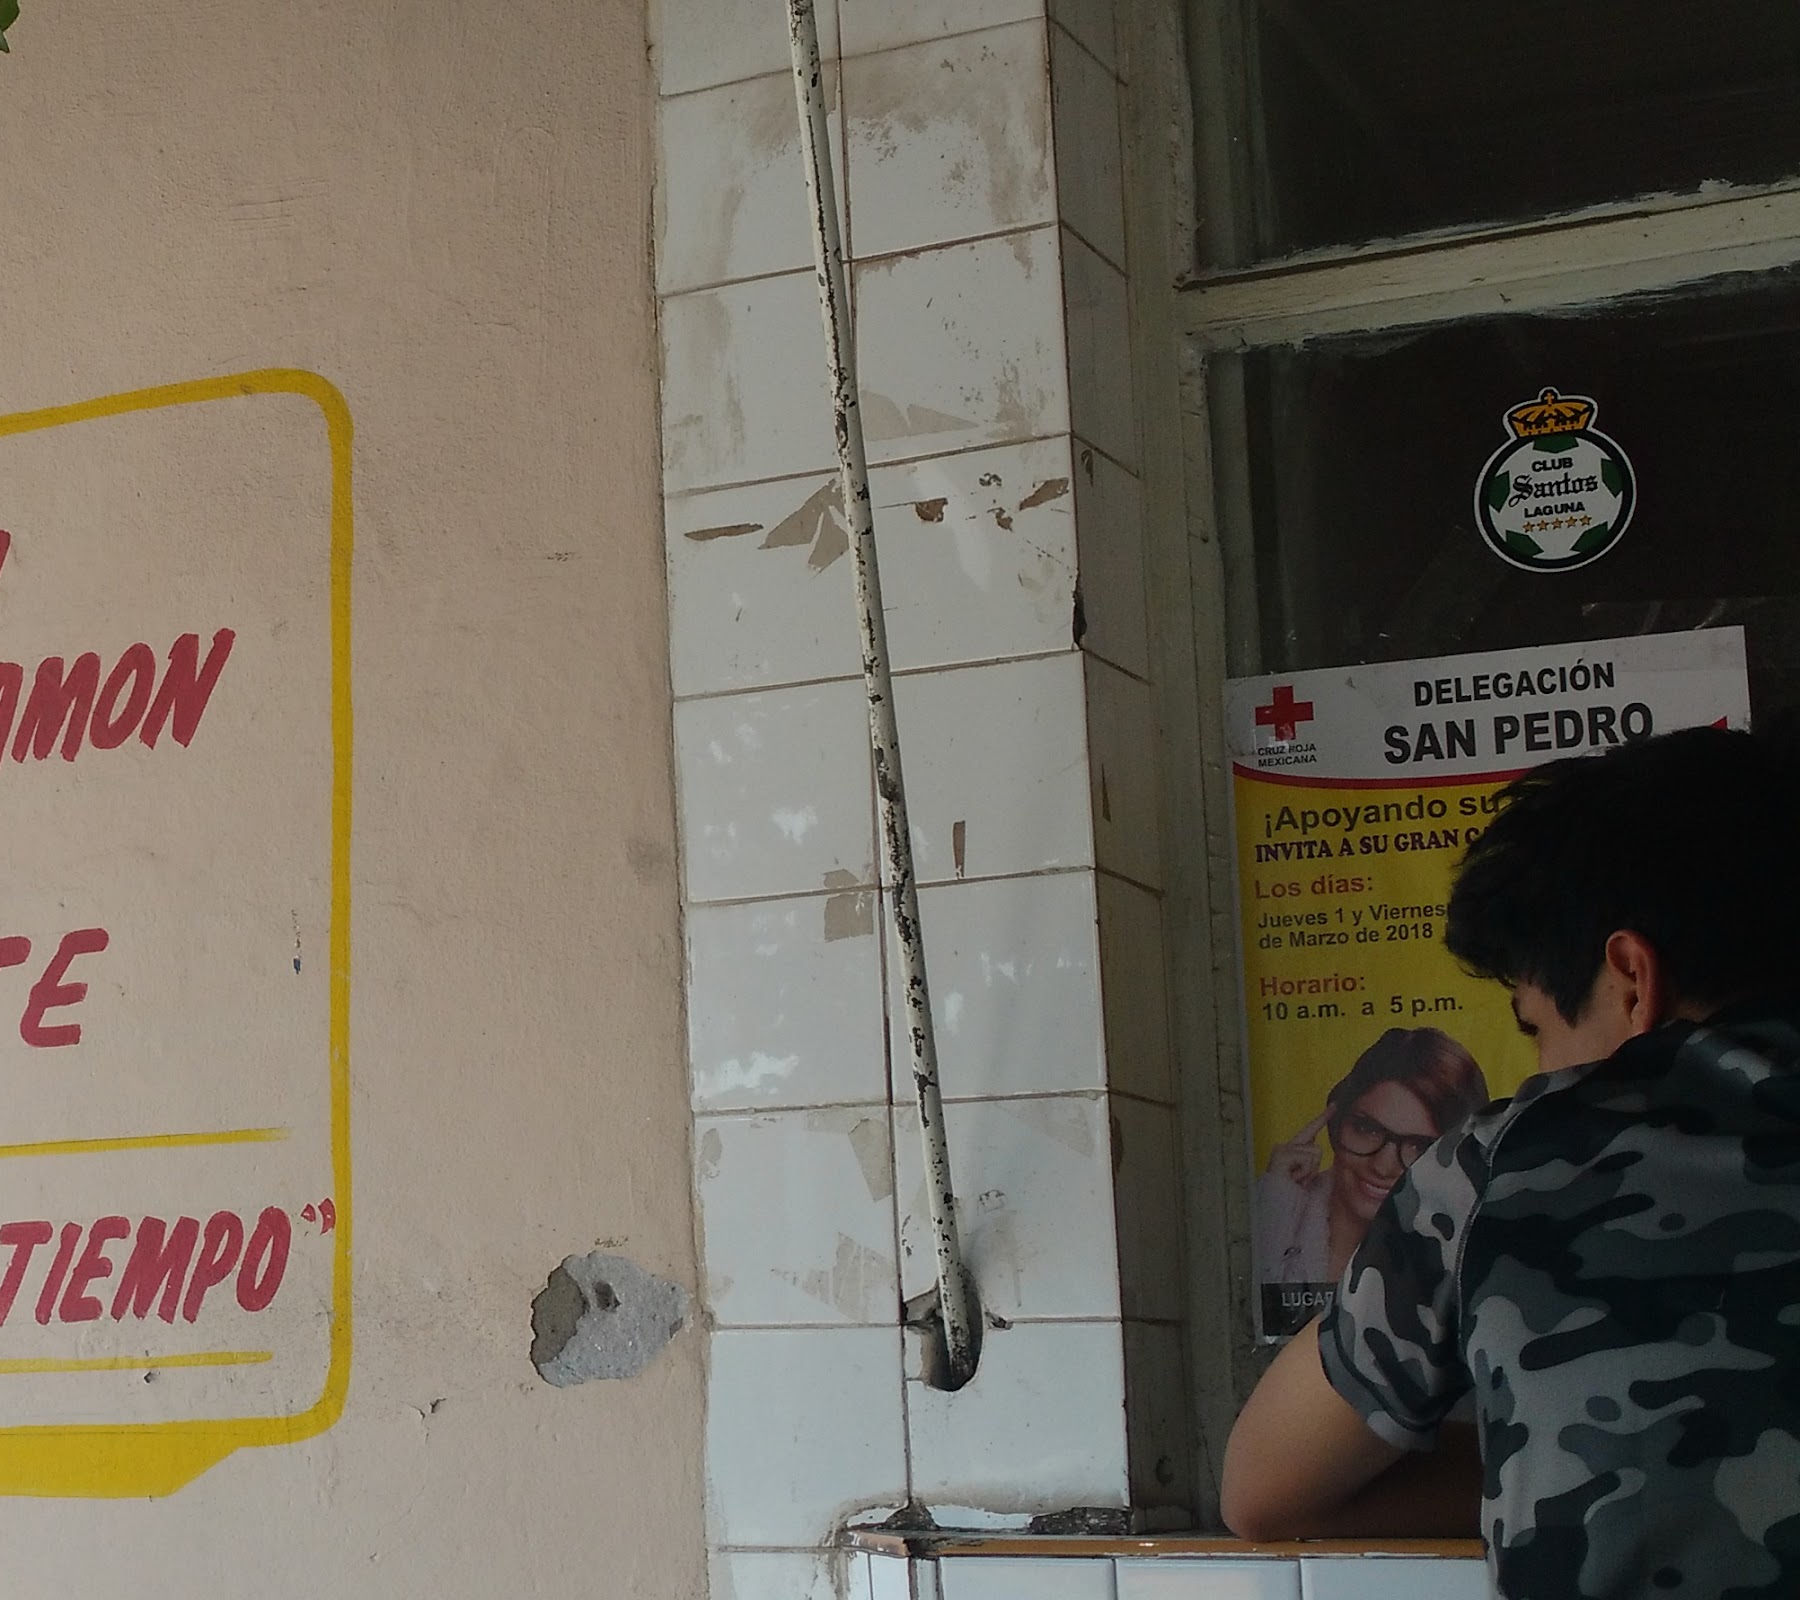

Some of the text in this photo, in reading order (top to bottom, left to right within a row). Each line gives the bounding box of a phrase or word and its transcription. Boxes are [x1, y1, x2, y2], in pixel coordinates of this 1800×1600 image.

[1532, 458, 1573, 472] CLUB
[1509, 473, 1598, 507] Santos
[1524, 501, 1585, 518] LAGUNA
[1414, 659, 1614, 707] DELEGACIÓN
[1384, 702, 1654, 764] SAN PEDRO
[1258, 744, 1316, 757] CRUZ ROJA
[1258, 755, 1317, 767] MEXICANA
[1265, 795, 1447, 837] ¡Apoyando
[1256, 840, 1333, 863] INVITA
[1338, 839, 1354, 857] A
[1360, 835, 1388, 855] SU
[1394, 829, 1459, 851] GRAN
[1255, 874, 1373, 899] Los días:
[1258, 903, 1446, 929] Jueves 1 y Viernes
[1259, 922, 1432, 949] de Marzo de 2018
[1260, 973, 1365, 996] Horario:
[1262, 995, 1463, 1021] 10 a.m. a 5 p.m.
